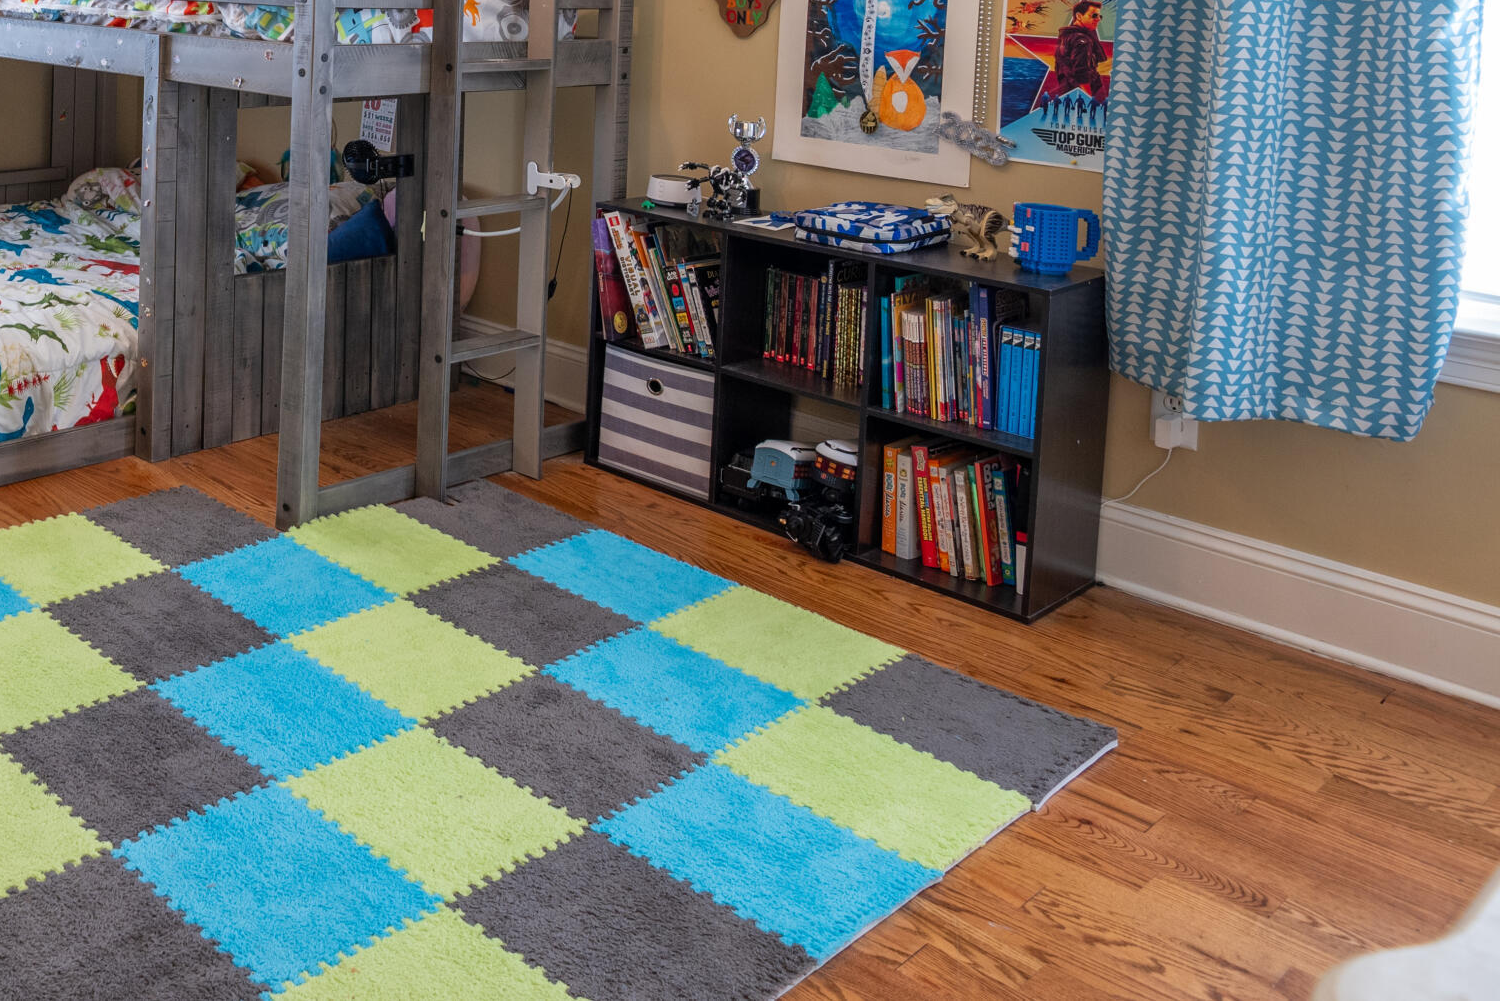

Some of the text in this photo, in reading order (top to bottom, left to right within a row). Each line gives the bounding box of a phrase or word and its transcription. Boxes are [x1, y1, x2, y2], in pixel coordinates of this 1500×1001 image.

[726, 10, 763, 26] ONLY
[1052, 130, 1102, 148] TOP GUN
[1071, 125, 1104, 134] CRUISE
[1056, 144, 1096, 155] MAVERICK
[619, 256, 635, 296] DICTIONARY
[624, 255, 641, 296] VISUAL
[917, 476, 925, 509] ESSENTIAL
[920, 509, 928, 541] HANDBOOK
